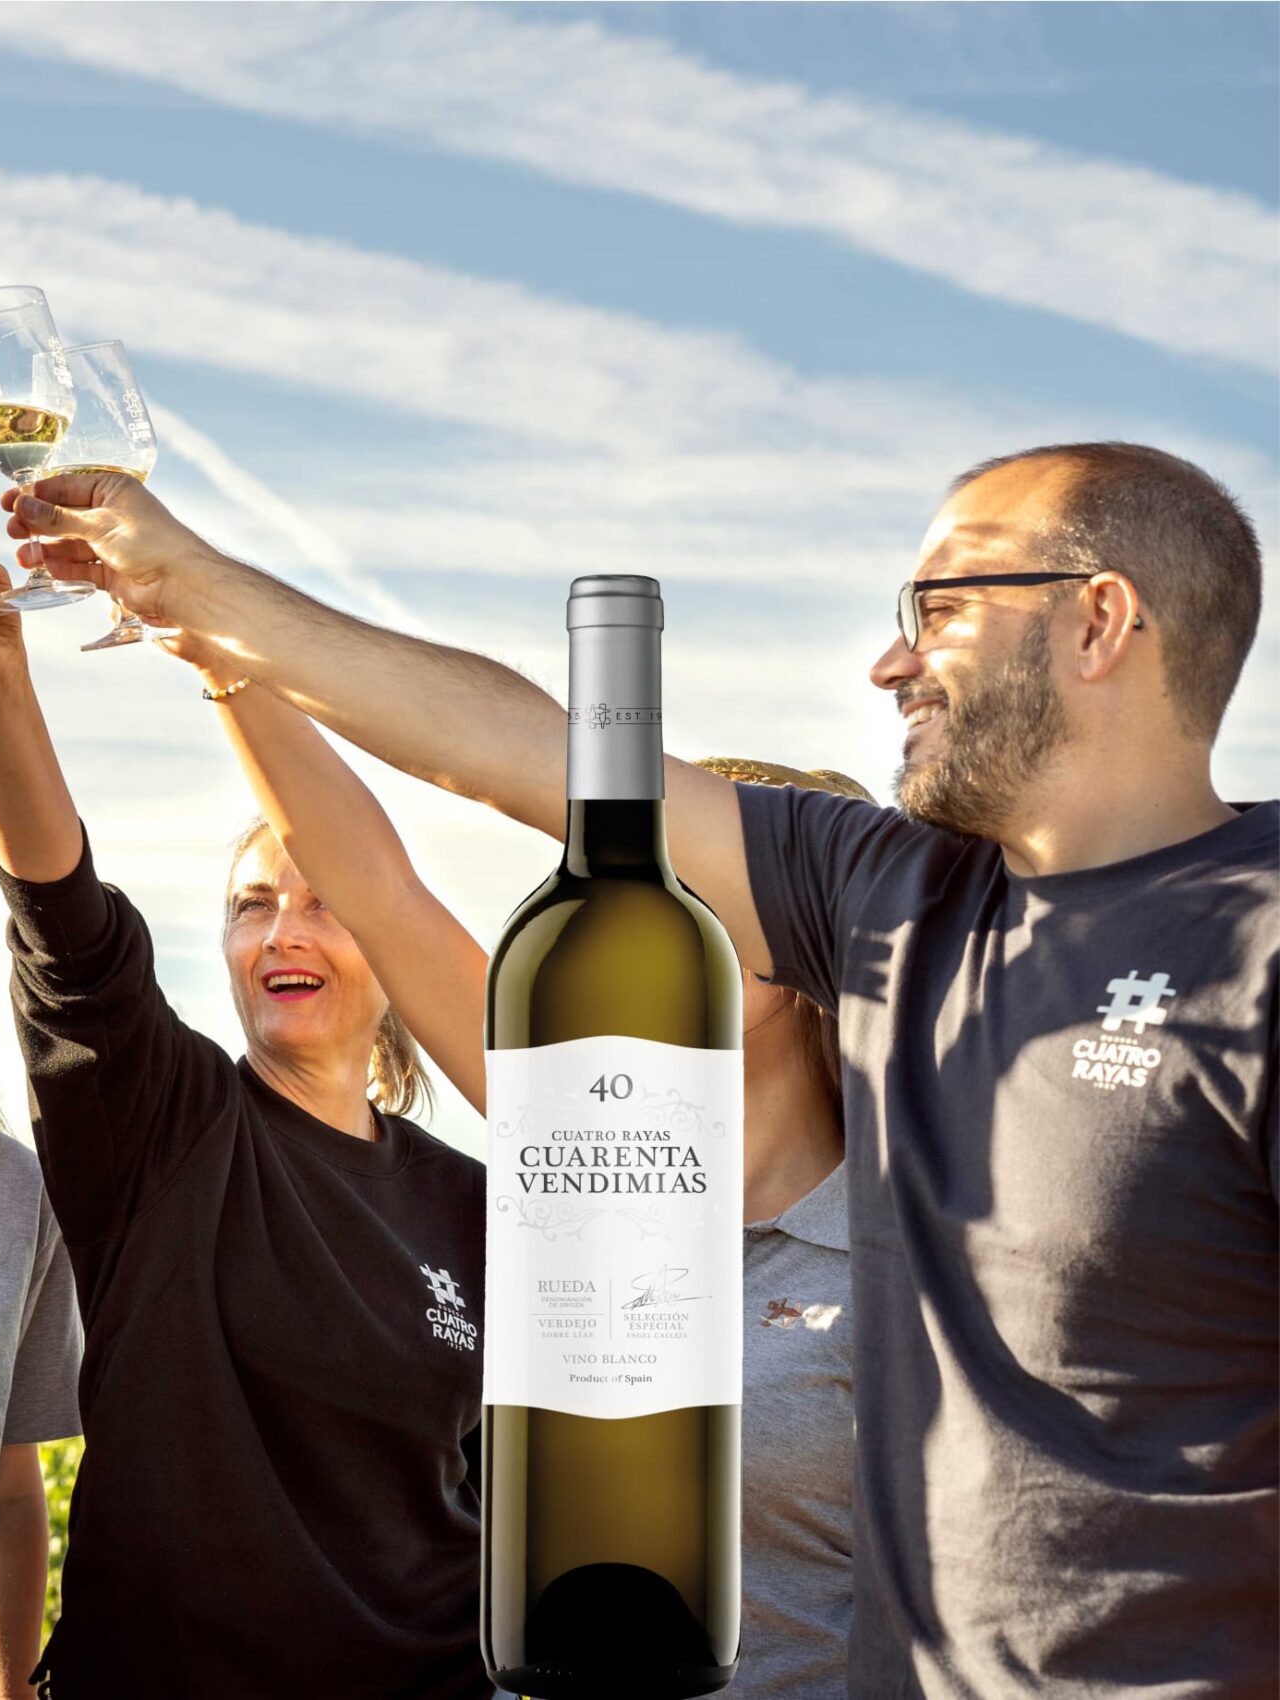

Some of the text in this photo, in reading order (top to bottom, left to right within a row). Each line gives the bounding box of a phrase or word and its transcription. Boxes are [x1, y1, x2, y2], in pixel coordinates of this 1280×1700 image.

[1072, 1039, 1161, 1068] CUATRO
[1072, 1059, 1148, 1087] RAYAS
[589, 1073, 634, 1102] 40
[551, 1130, 671, 1141] CUATRO RAYAS
[519, 1145, 702, 1167] CUARENTA
[516, 1172, 707, 1193] VENDIMIAS
[537, 1280, 597, 1293] RUEDA
[426, 1308, 477, 1338] CUATRO
[538, 1319, 597, 1330] VERDEJO
[623, 1311, 689, 1321] SELECCIÓN
[629, 1321, 684, 1330] ESPECIAL
[433, 1323, 475, 1351] RAYAS
[563, 1354, 657, 1364] VINO BLANCO
[569, 1374, 652, 1386] Product of Spain
